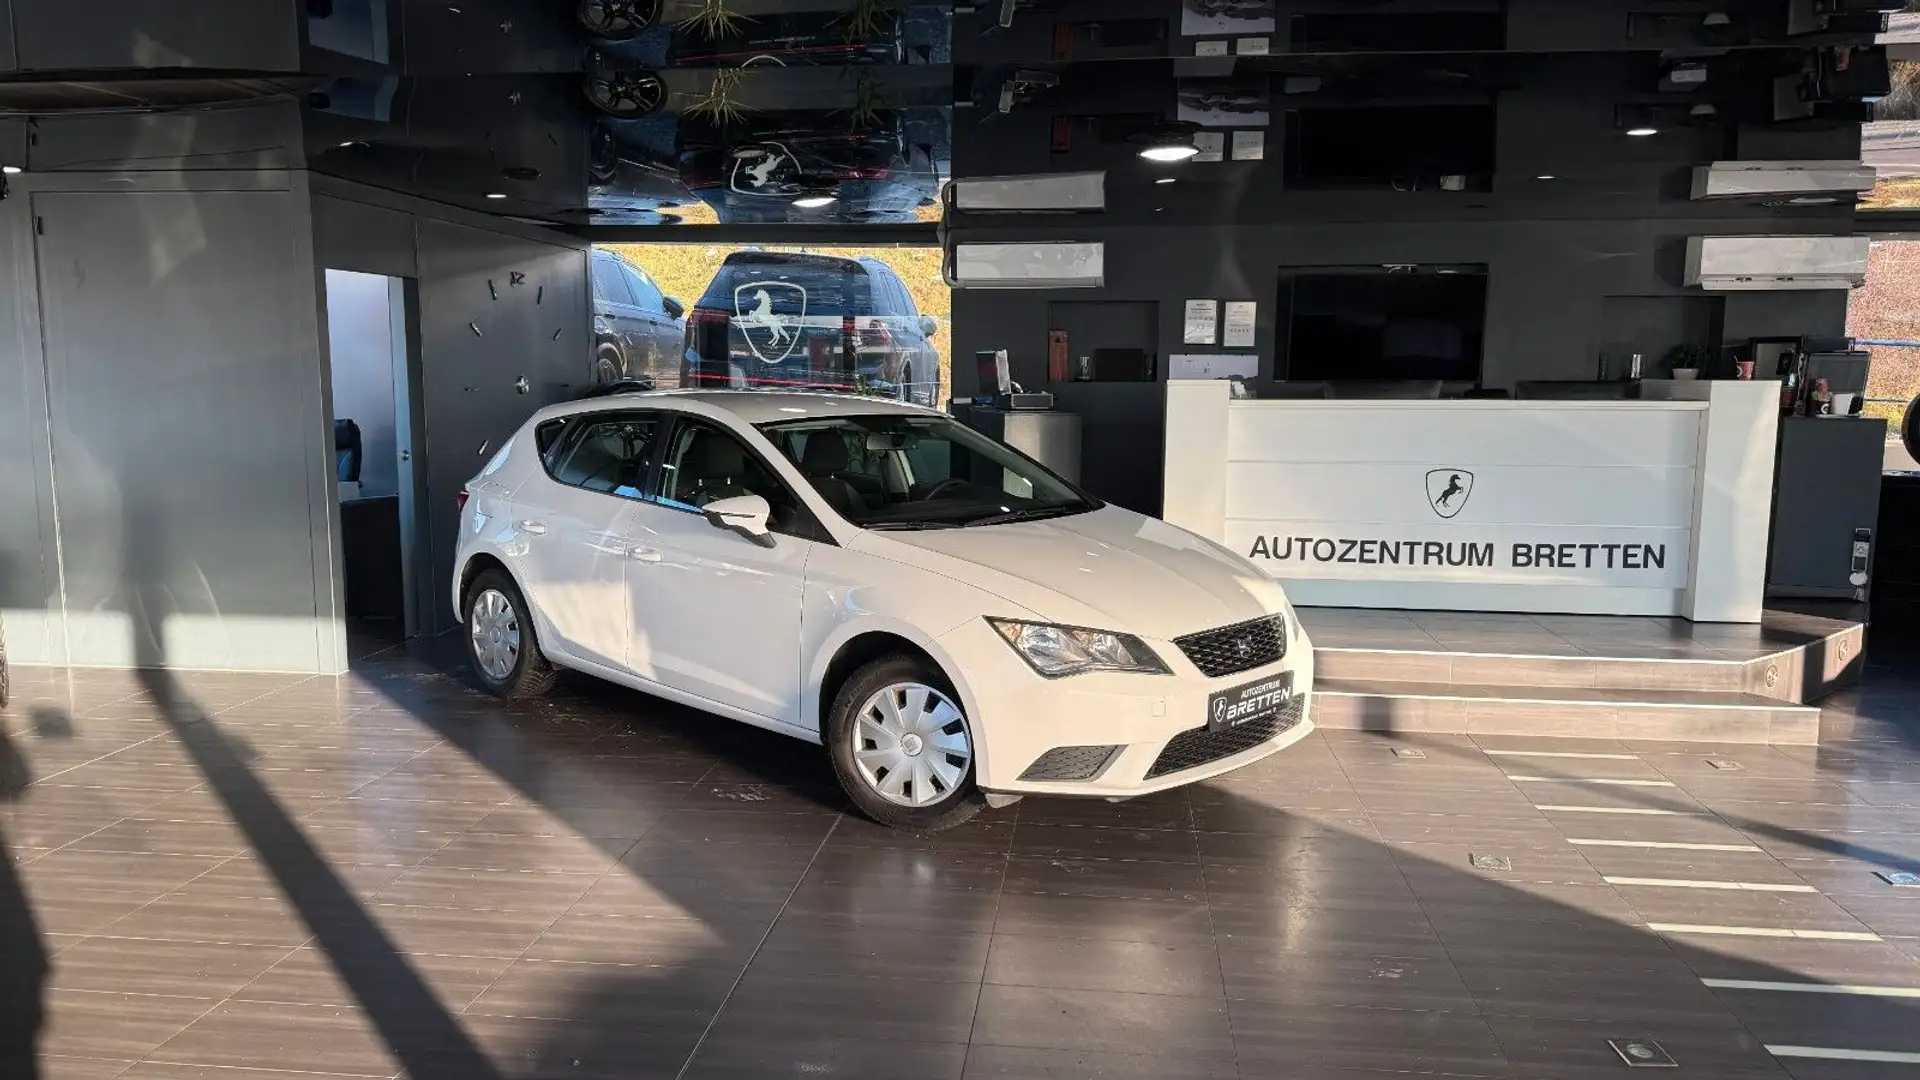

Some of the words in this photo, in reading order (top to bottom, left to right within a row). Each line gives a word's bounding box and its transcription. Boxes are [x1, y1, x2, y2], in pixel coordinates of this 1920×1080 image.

[1249, 535, 1494, 567] AUTOZENTRUM
[1512, 543, 1666, 569] BRETTEN
[1226, 686, 1291, 720] BRETTEN
[1241, 680, 1280, 699] AUTOZENTRUM
